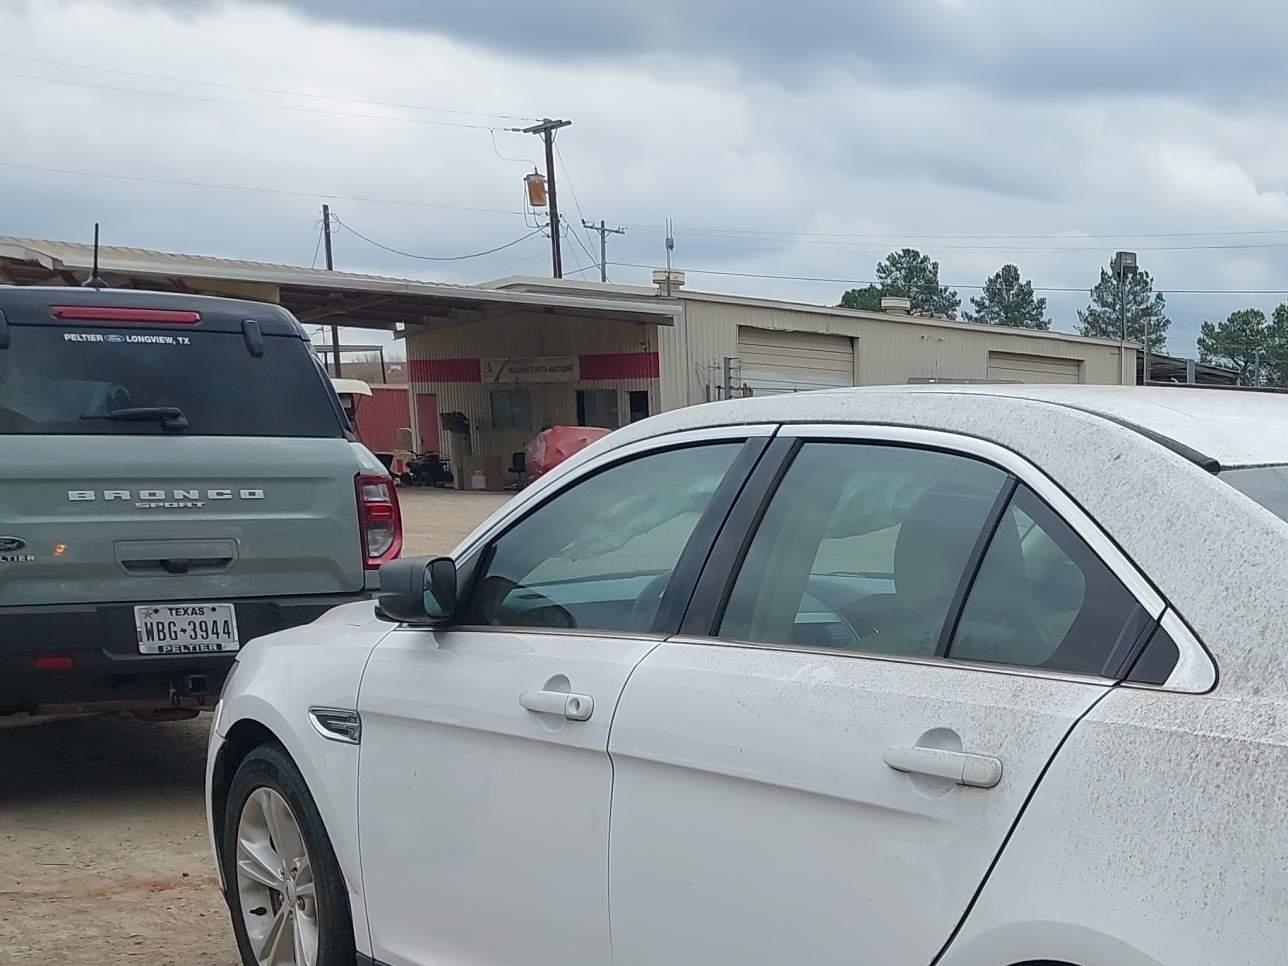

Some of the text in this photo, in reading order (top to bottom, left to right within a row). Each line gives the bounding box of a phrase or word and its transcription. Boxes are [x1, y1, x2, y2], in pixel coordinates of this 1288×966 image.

[64, 333, 103, 342] PELTIER
[126, 334, 177, 345] LONGVIEW,
[178, 337, 190, 345] TX
[68, 490, 265, 501] BRONCO
[135, 501, 206, 509] SPORT
[168, 607, 205, 617] TEXAS
[164, 644, 217, 653] PELTIER
